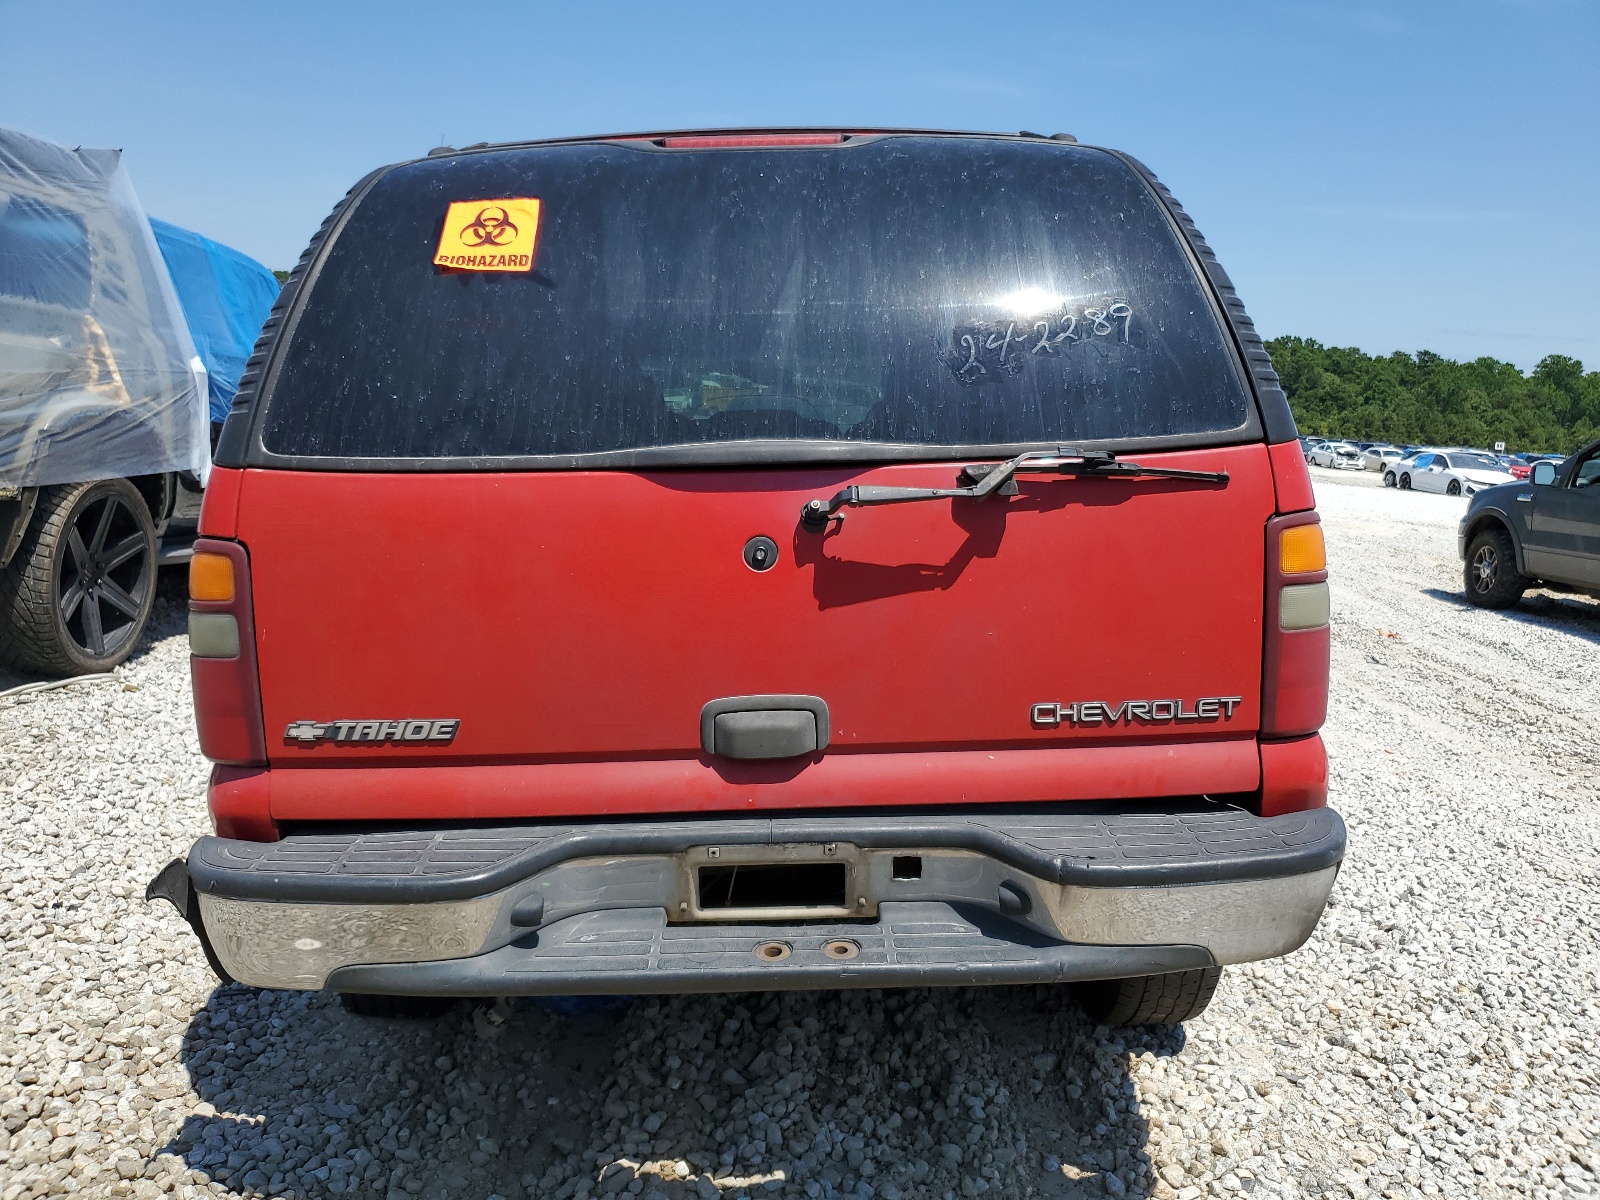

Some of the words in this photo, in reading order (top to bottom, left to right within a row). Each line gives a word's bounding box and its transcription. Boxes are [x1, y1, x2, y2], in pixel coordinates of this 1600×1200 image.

[438, 254, 529, 267] BIOHAZARD
[959, 303, 1133, 374] 24-2289
[1031, 697, 1242, 723] CHEVROLET
[334, 720, 458, 741] TAHOE
